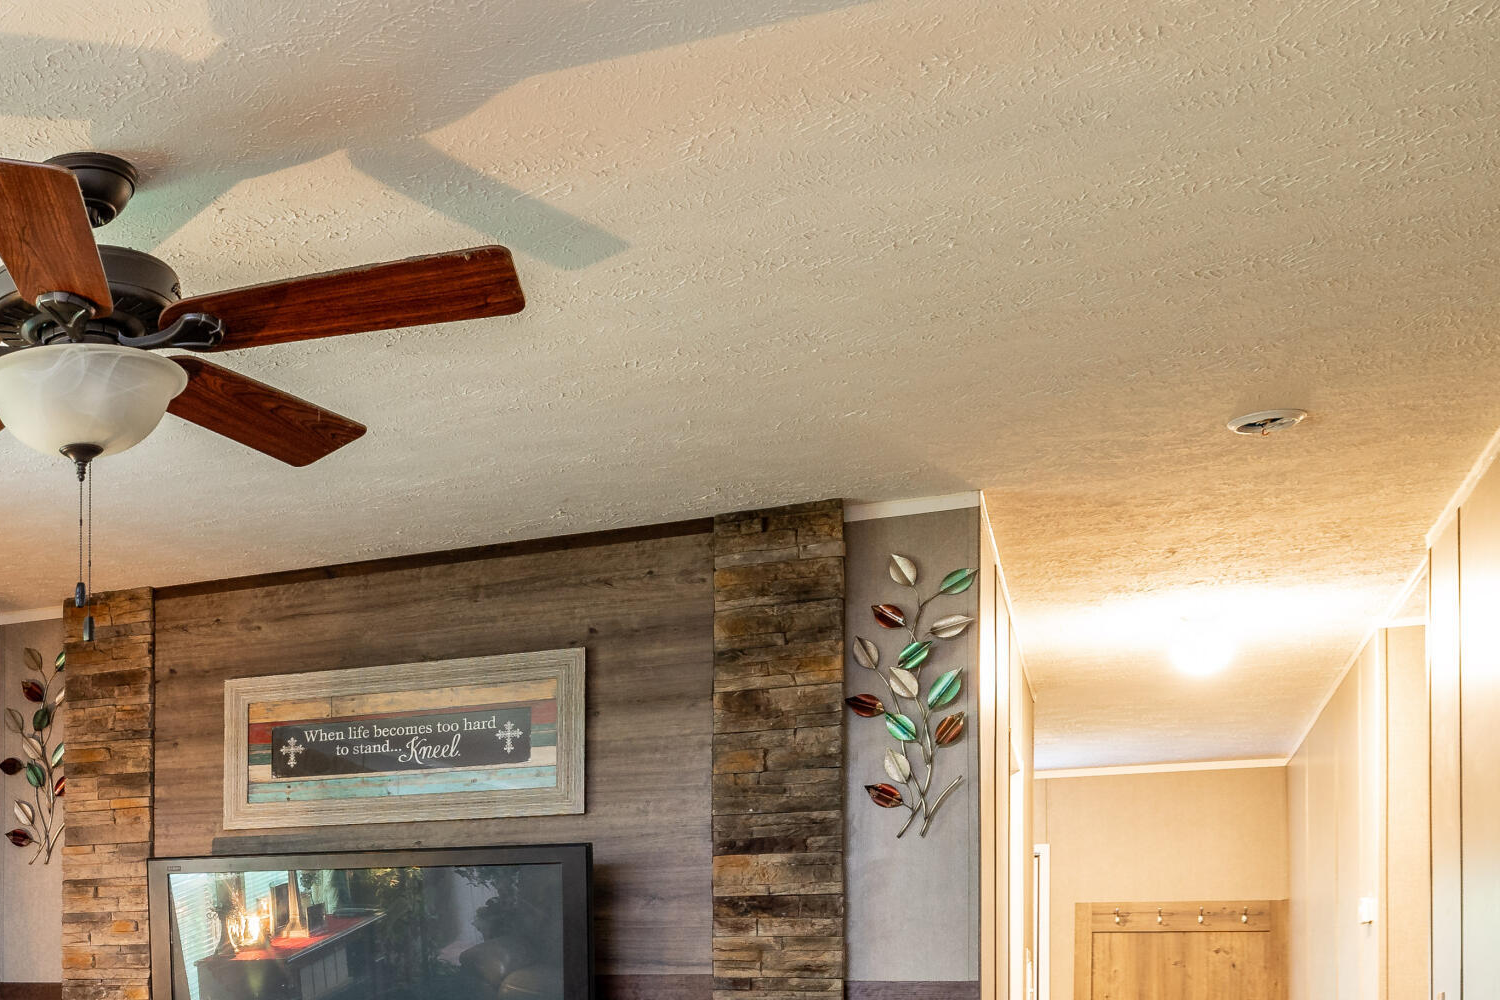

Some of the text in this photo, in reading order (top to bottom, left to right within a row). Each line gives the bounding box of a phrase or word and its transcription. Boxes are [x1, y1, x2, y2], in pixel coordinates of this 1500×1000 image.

[304, 715, 497, 743] When life becomes too hard
[336, 744, 350, 756] to
[352, 740, 402, 756] stand...
